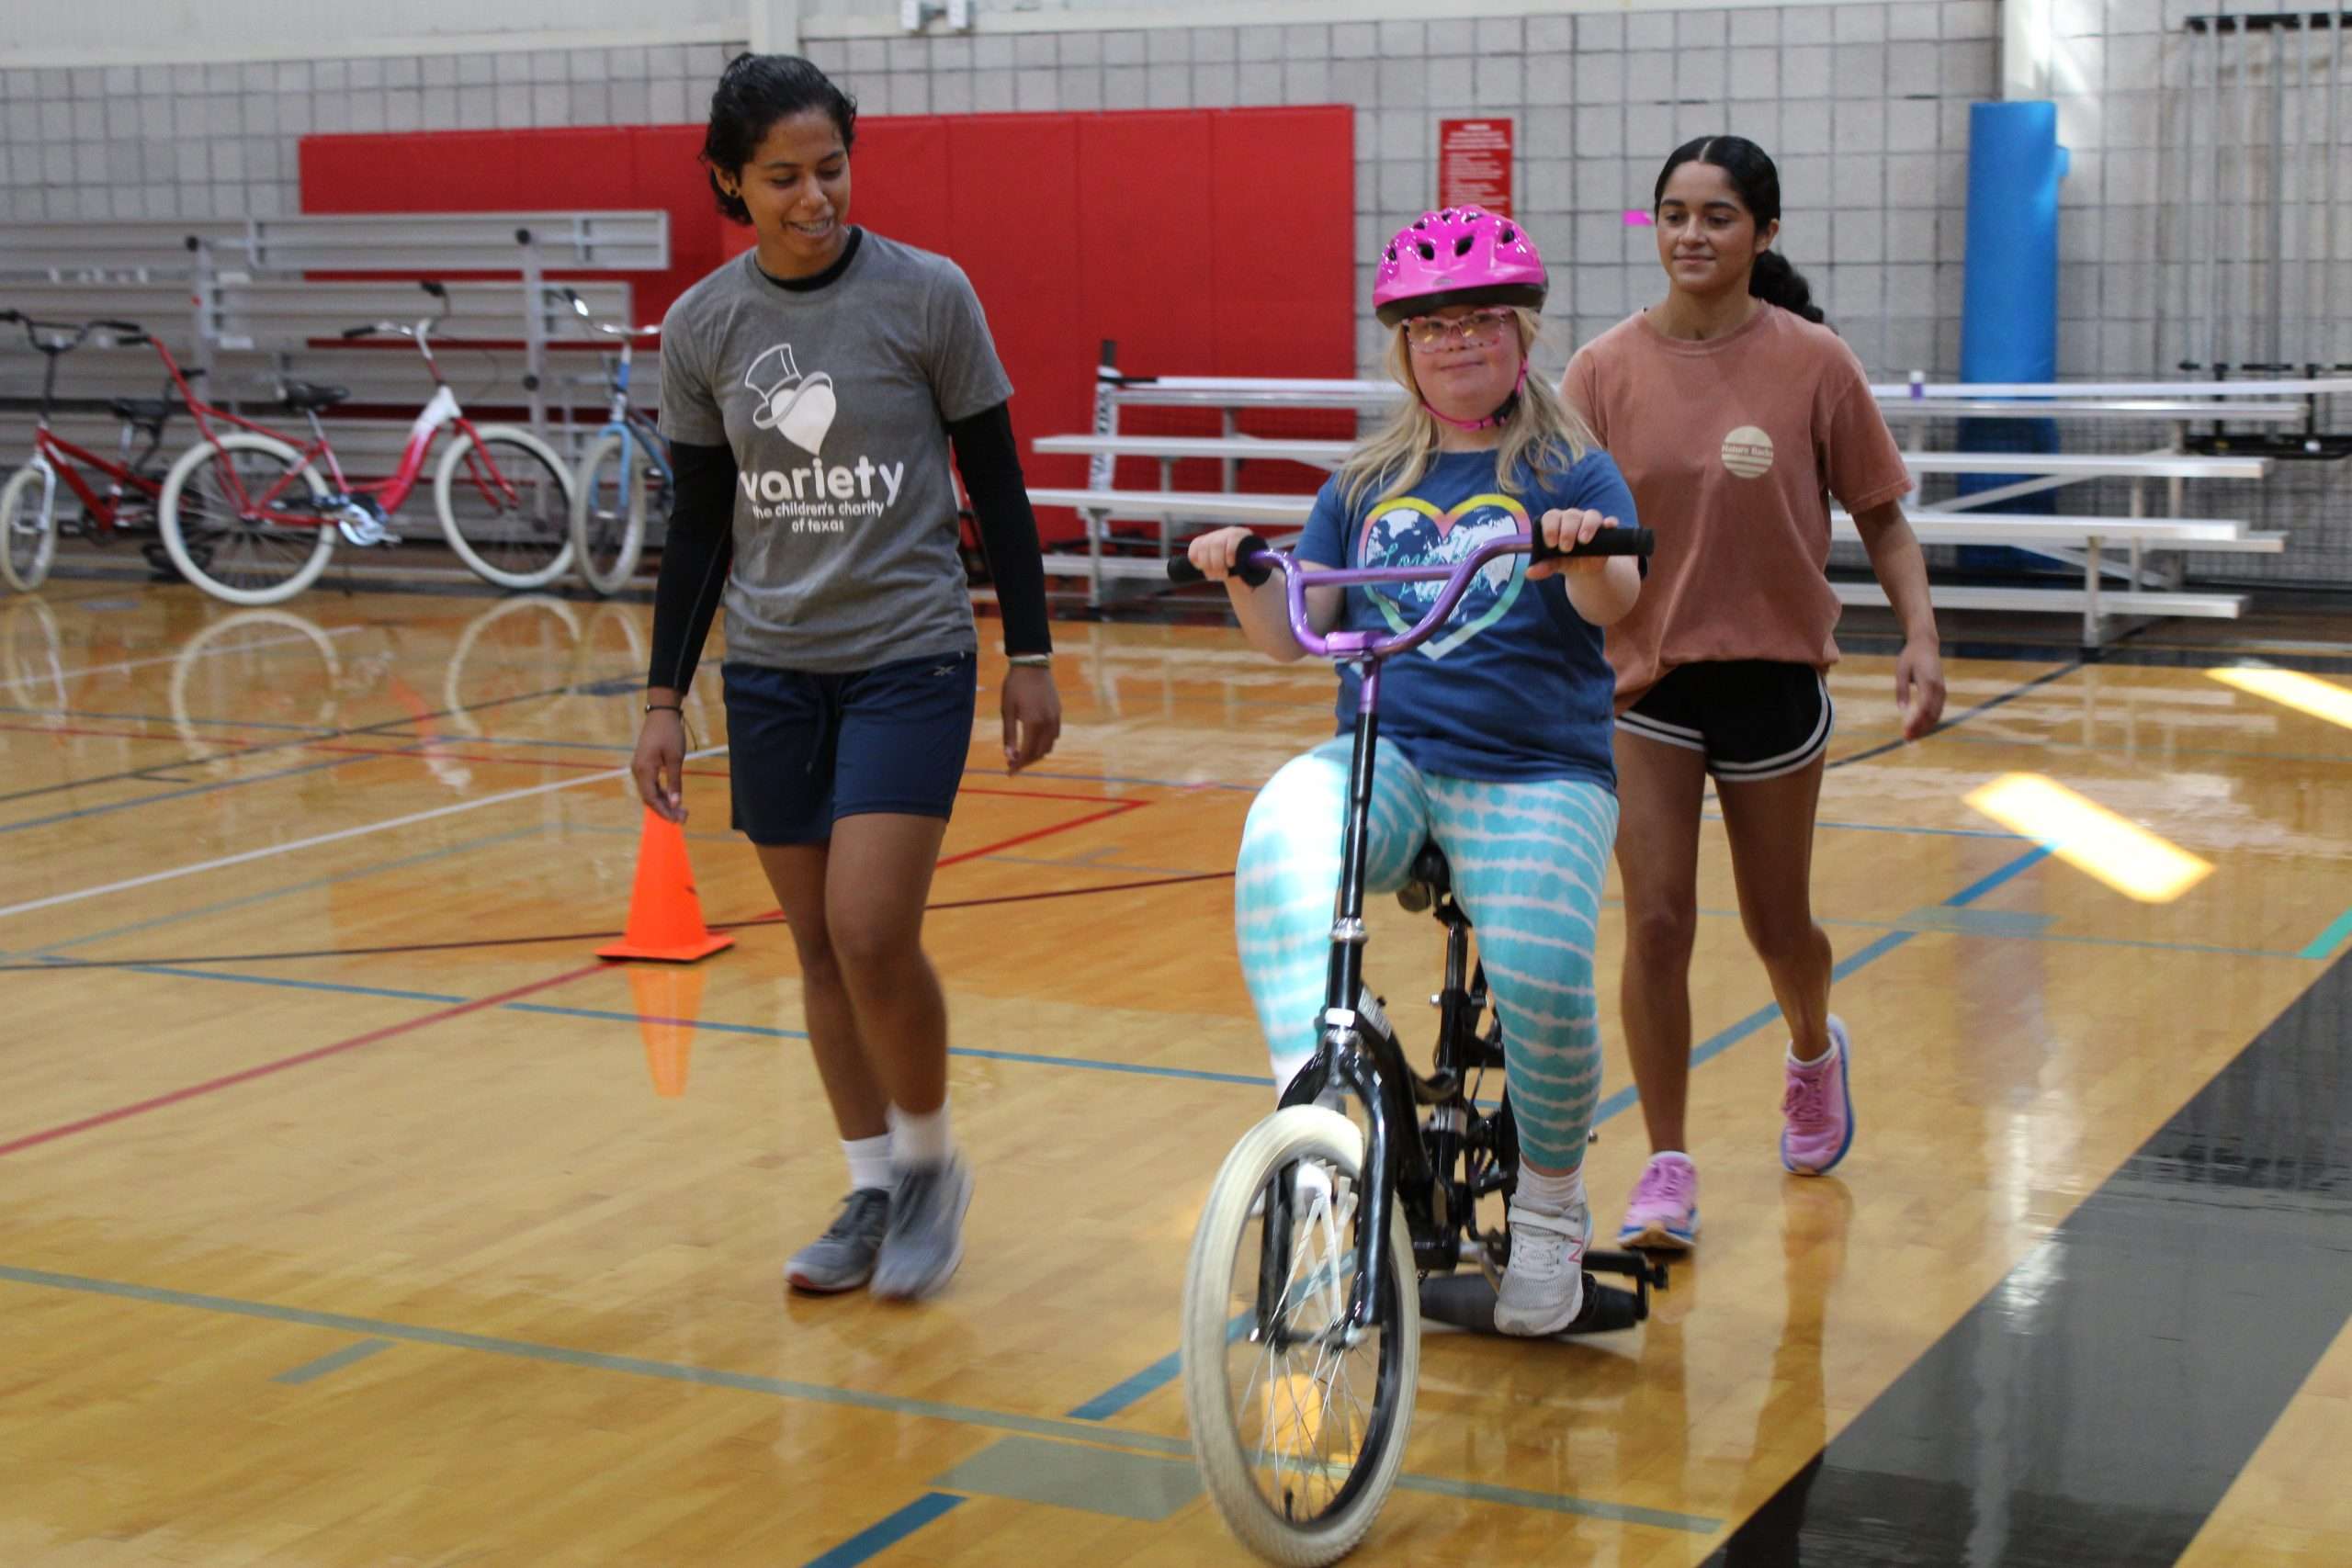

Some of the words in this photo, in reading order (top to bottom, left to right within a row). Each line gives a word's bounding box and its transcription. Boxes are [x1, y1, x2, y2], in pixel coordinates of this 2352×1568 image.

[739, 455, 905, 507] variety
[775, 501, 835, 517] children's
[838, 499, 885, 518] charity
[791, 517, 805, 534] of
[807, 518, 844, 534] texas
